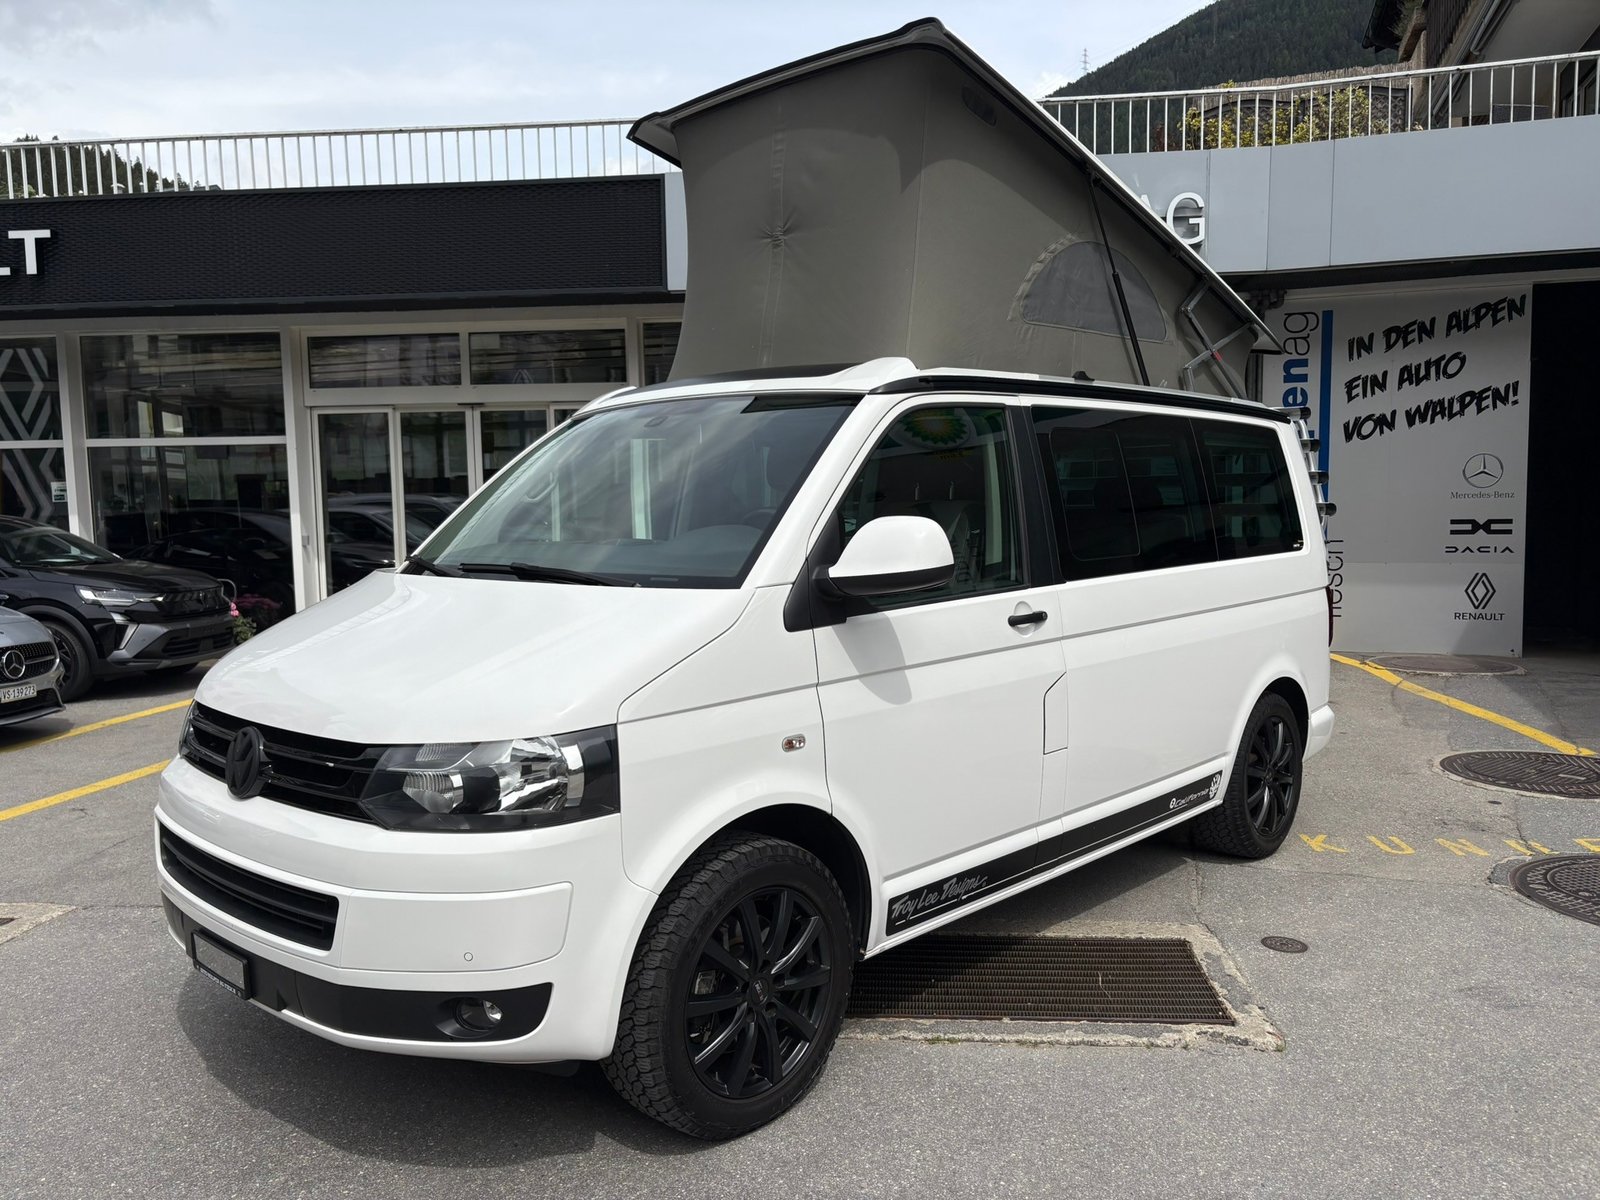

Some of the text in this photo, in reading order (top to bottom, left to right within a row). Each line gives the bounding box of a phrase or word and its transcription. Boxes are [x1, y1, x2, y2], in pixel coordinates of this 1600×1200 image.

[1347, 293, 1527, 362] IN DEN ALPEN
[1344, 351, 1467, 404] EIN AUTO
[1343, 380, 1520, 444] VON WALPEN!
[1450, 490, 1515, 499] Mercedes-Benz
[1445, 545, 1515, 554] DACIA
[1454, 612, 1506, 621] RENAULT
[891, 895, 919, 920] Troy
[917, 889, 940, 910] Lee
